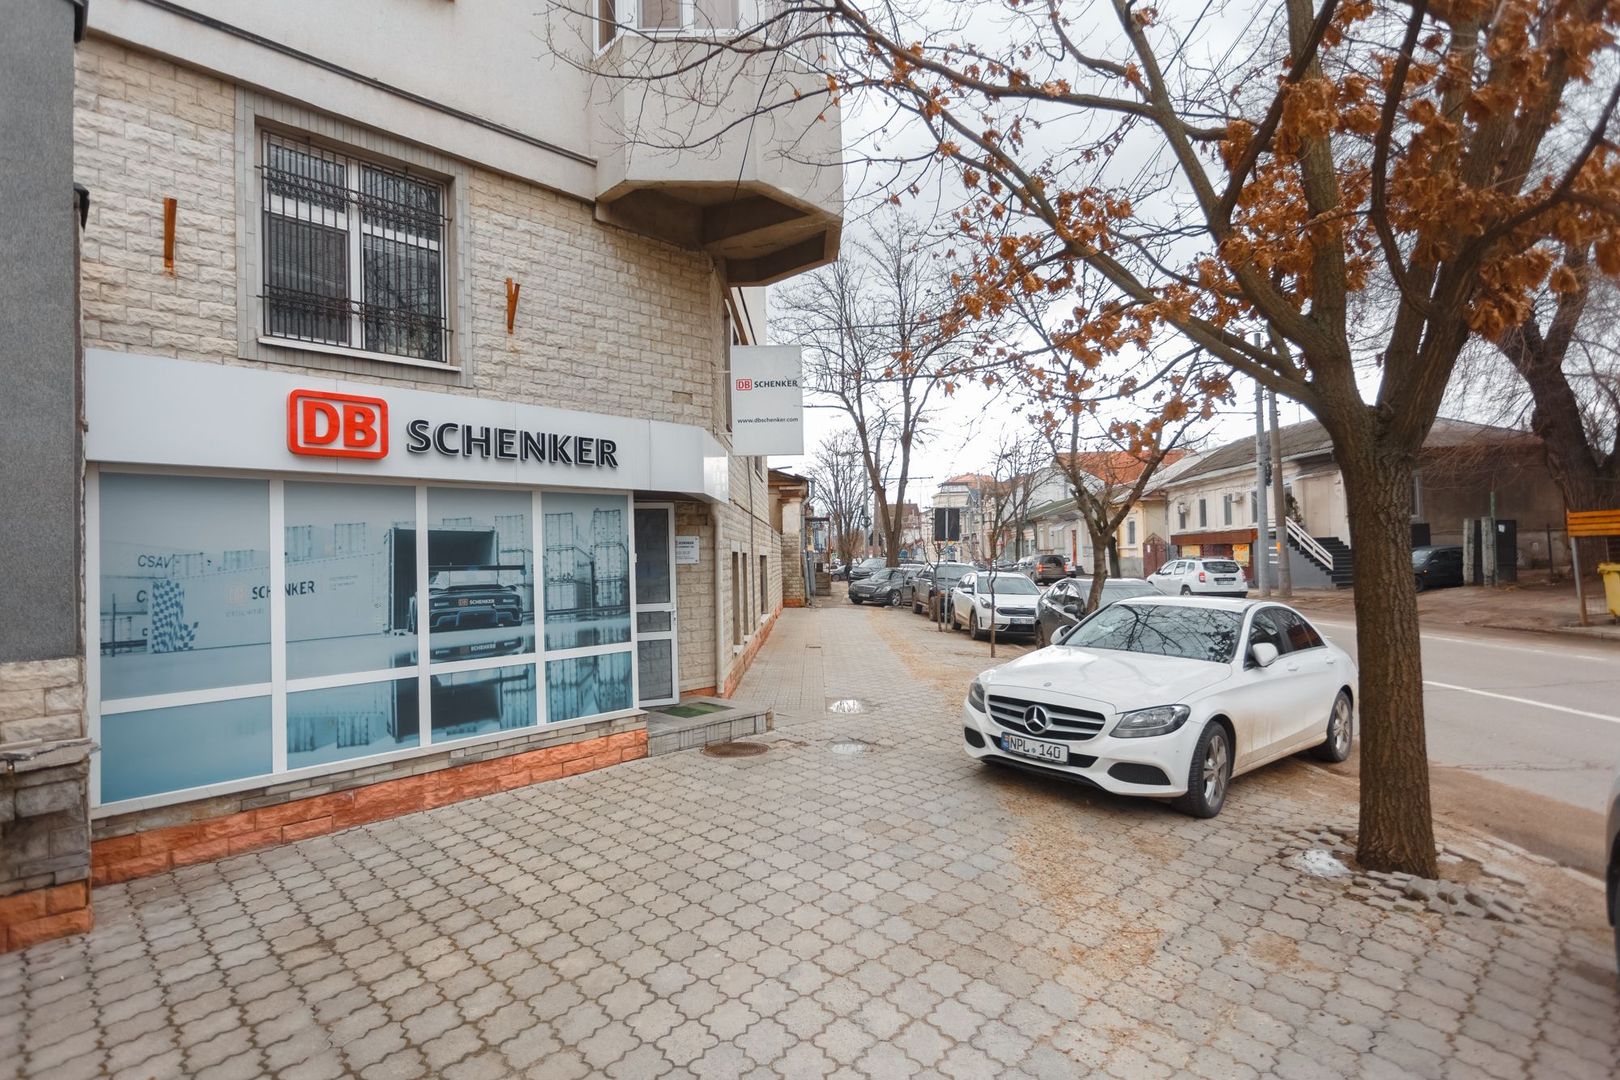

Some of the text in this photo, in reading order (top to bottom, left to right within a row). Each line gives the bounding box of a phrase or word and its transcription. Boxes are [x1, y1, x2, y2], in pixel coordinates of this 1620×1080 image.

[738, 379, 798, 389] DB SCHENKER
[302, 400, 619, 469] DB SCHENKER
[137, 554, 172, 569] CSAV
[251, 581, 316, 600] SCHNKER
[1010, 736, 1061, 759] NPL 140
